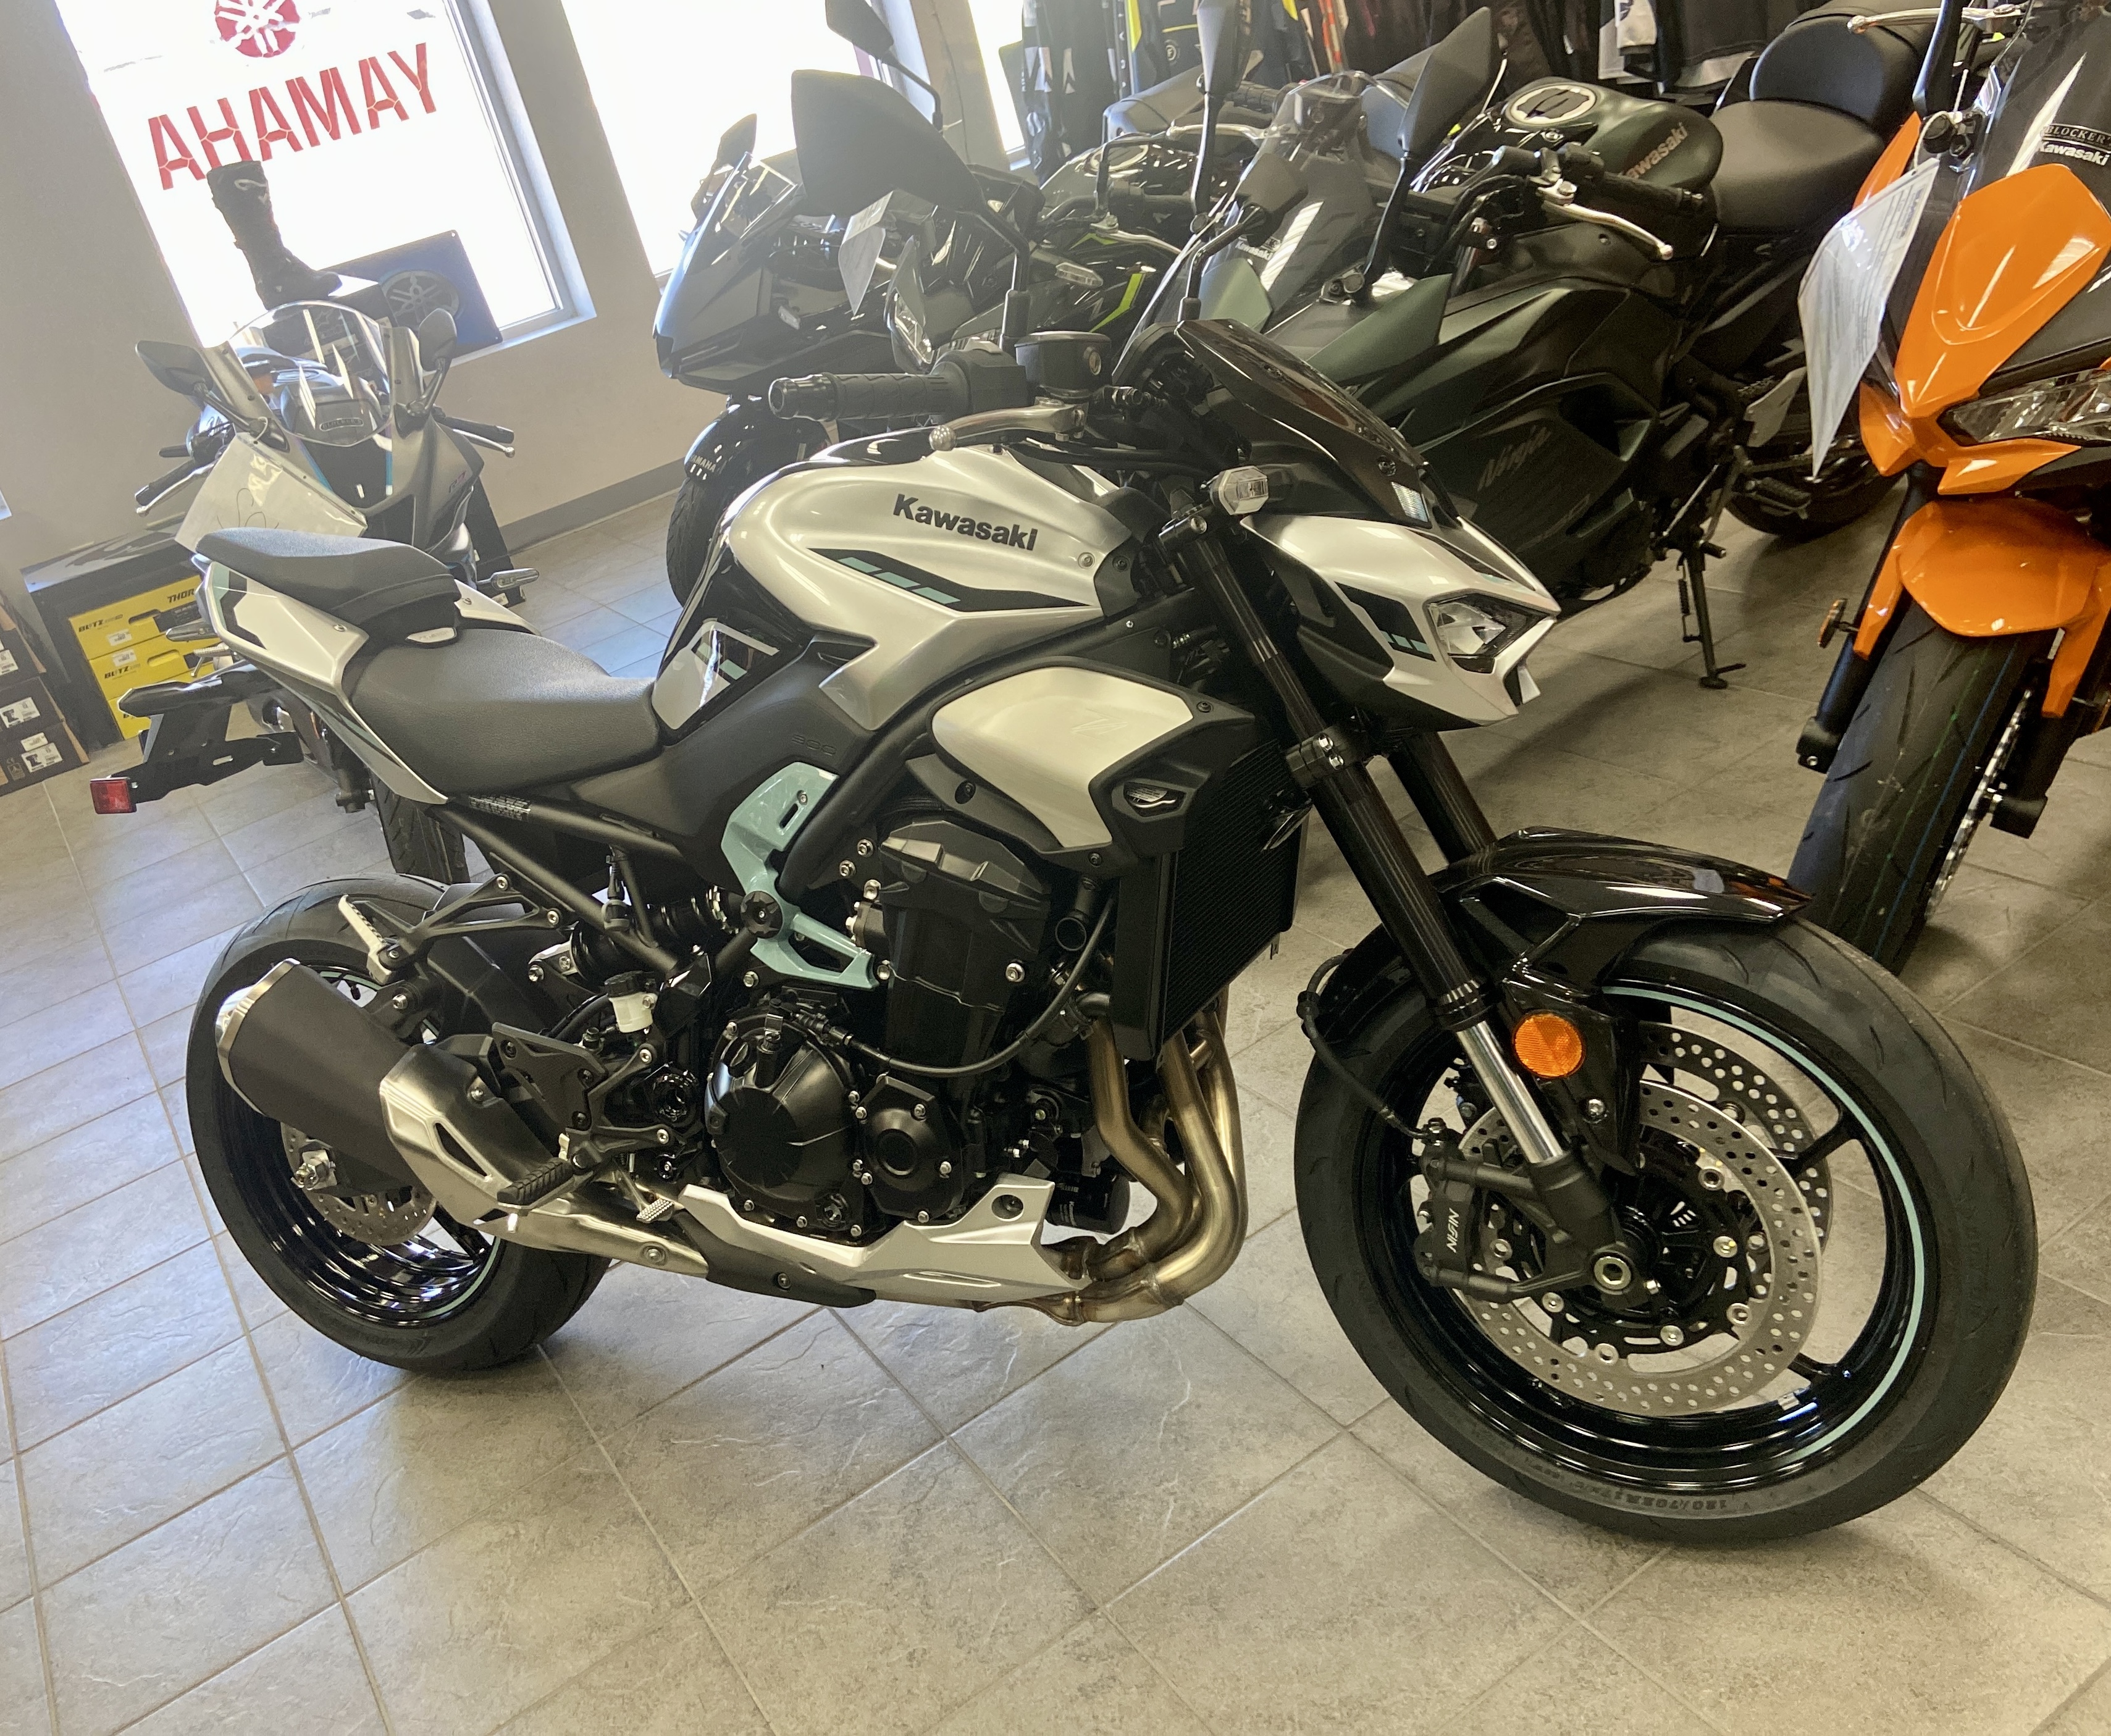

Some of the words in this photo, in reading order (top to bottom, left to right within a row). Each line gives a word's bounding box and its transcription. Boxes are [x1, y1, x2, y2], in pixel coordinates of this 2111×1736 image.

[1619, 122, 1688, 180] awasaki
[2039, 141, 2110, 166] Kawasaki
[892, 493, 1038, 551] Kawasaki
[167, 588, 195, 603] THOR
[791, 734, 837, 756] 900
[1446, 1207, 1460, 1254] NISSIN
